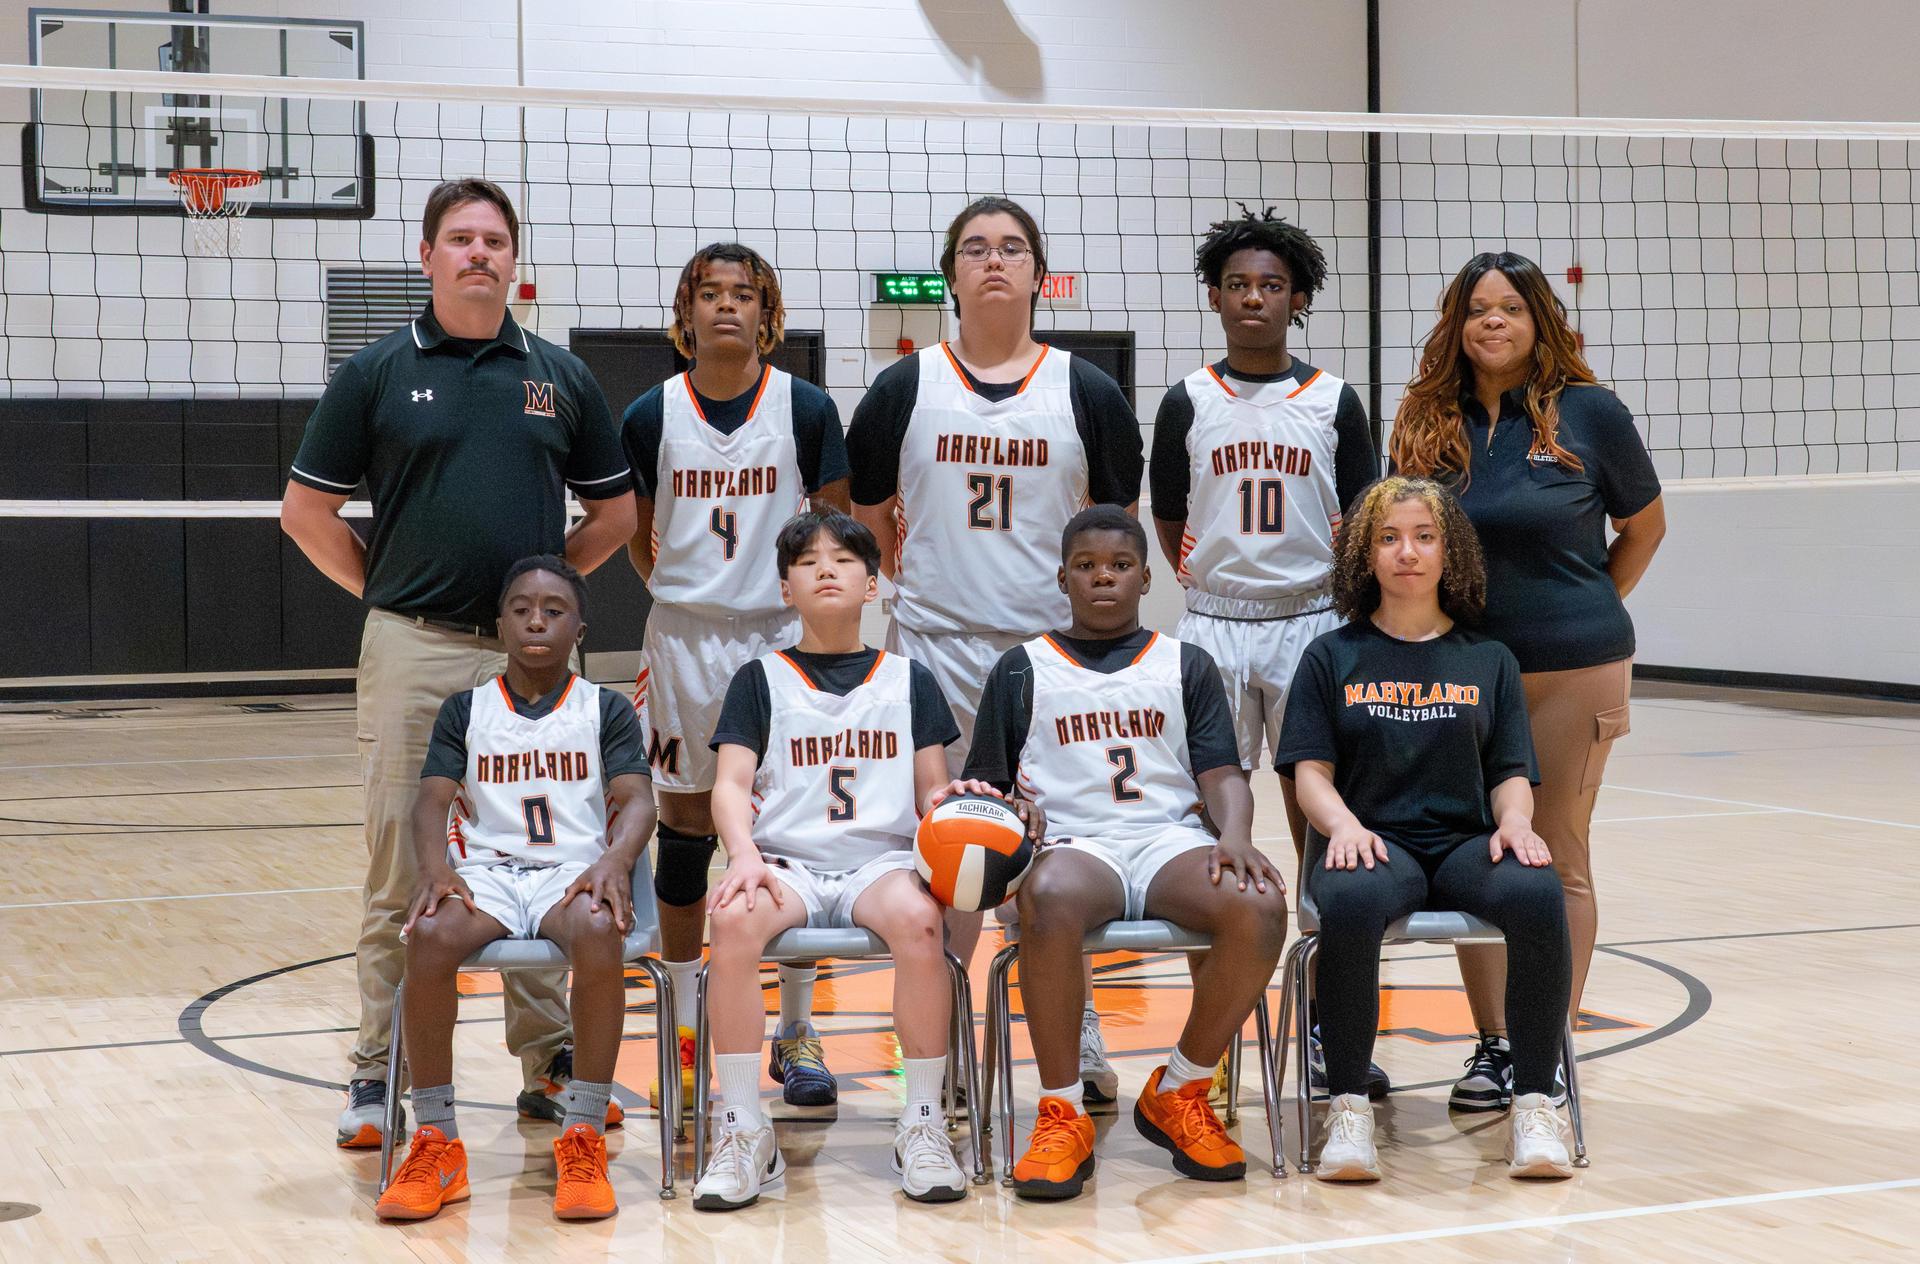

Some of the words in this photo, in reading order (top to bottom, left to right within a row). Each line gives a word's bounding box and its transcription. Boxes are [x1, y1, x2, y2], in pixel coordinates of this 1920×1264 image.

[1041, 275, 1075, 299] EXIT
[522, 380, 556, 413] M
[935, 433, 1049, 467] MARYLAND
[1210, 441, 1312, 477] MARYLAND
[672, 465, 777, 499] MARYLAND
[967, 472, 1013, 531] 21
[1237, 477, 1285, 535] 10
[709, 504, 739, 561] 4
[1344, 681, 1480, 708] MARYLAND
[1367, 704, 1457, 722] VOLLEYBALL
[1054, 708, 1166, 746] MARYLAND
[647, 726, 684, 776] M
[790, 728, 898, 767] MARYLAND
[477, 749, 589, 784] MARYLAND
[1105, 744, 1143, 804] 2
[827, 765, 857, 824] 5
[957, 803, 1005, 818] TACHIKARA
[520, 793, 556, 846] 0
